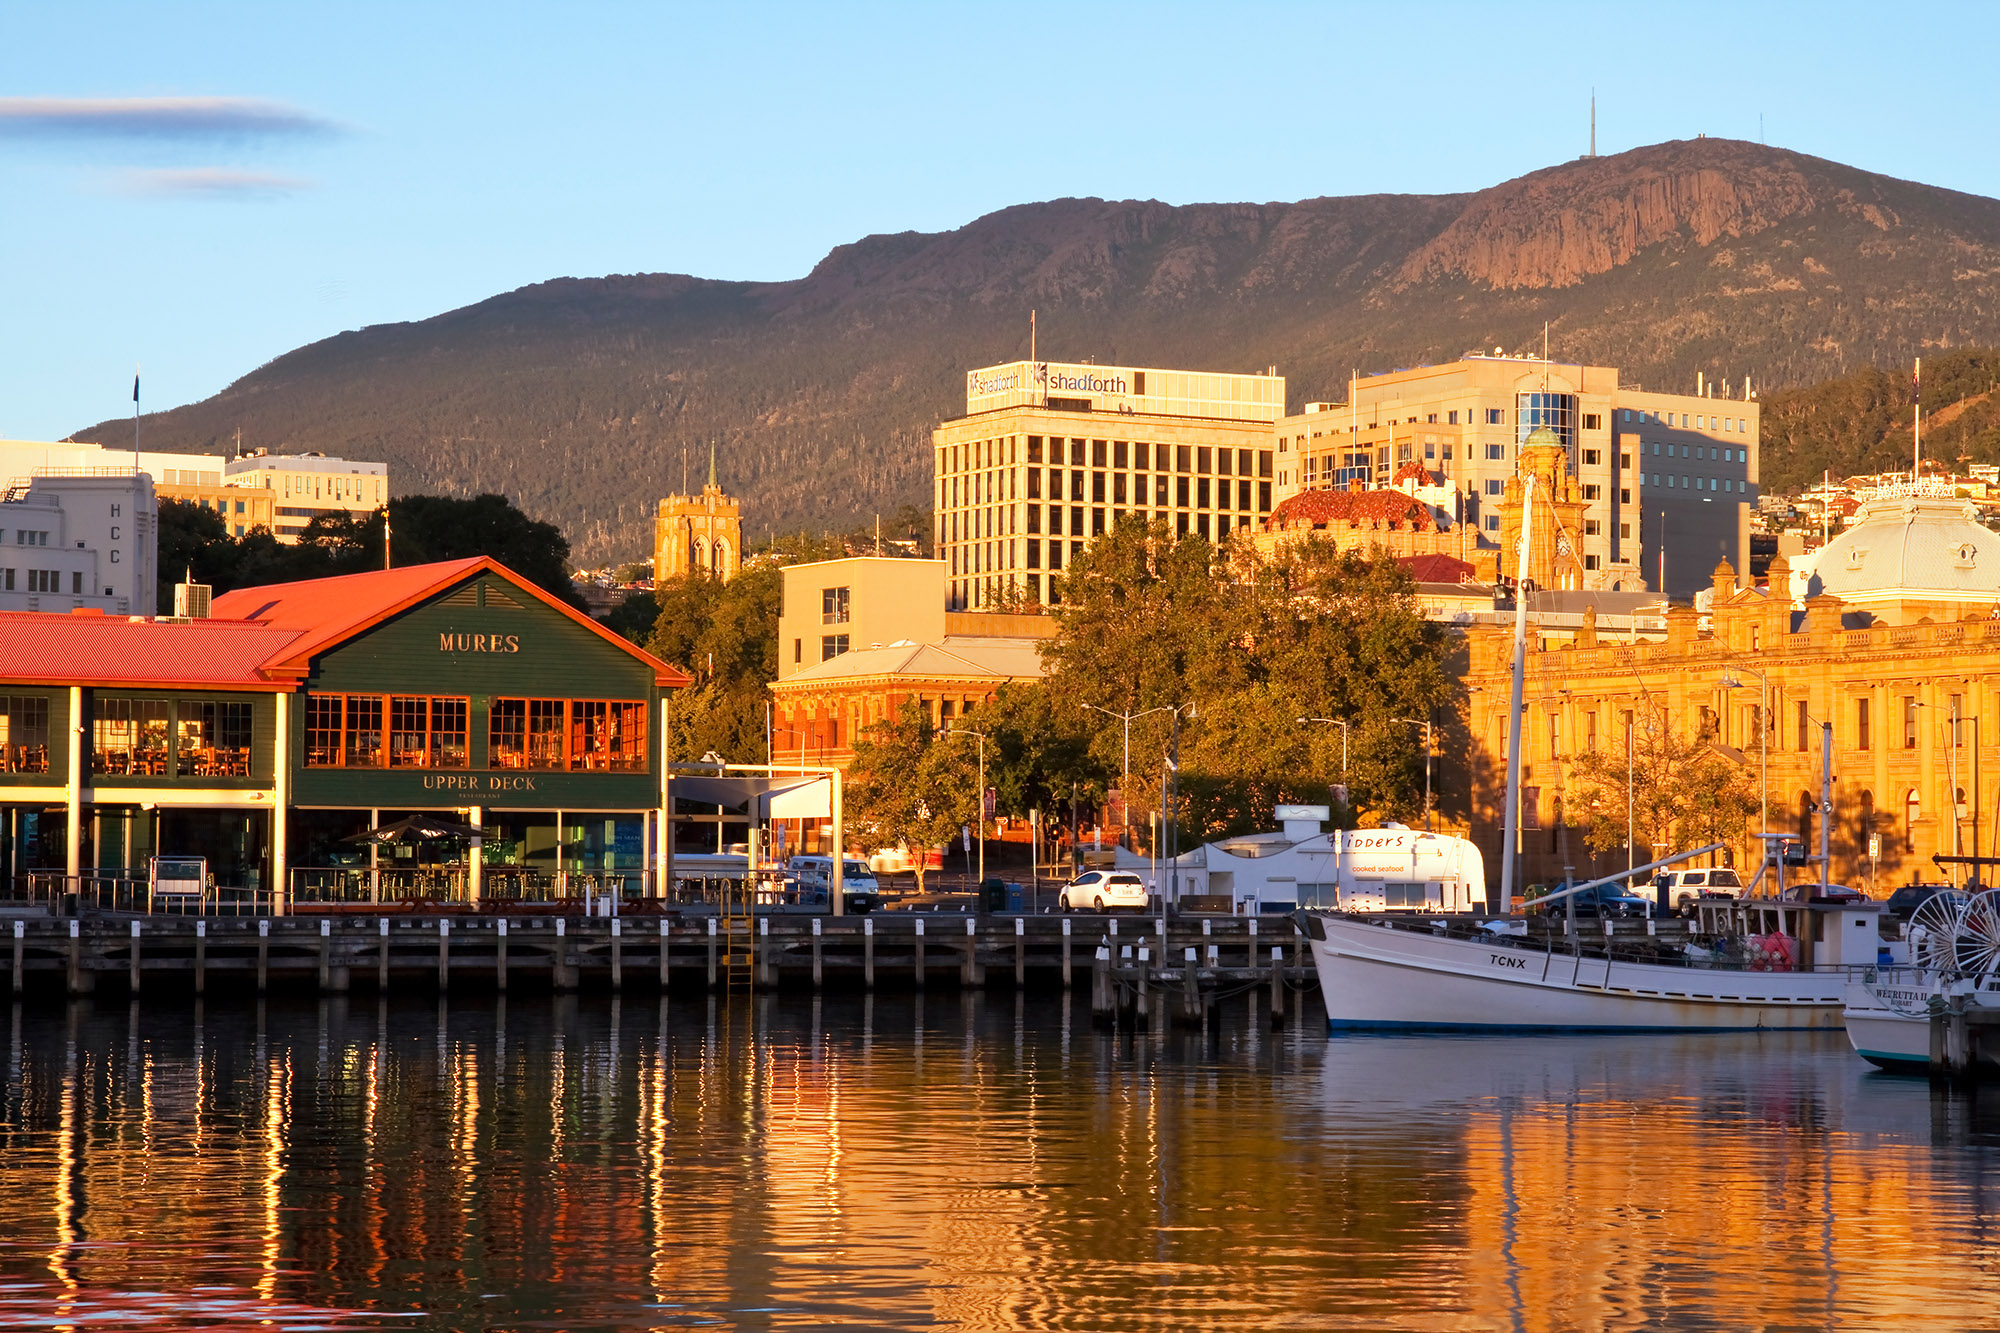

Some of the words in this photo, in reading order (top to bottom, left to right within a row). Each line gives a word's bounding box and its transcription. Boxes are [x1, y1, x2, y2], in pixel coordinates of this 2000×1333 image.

[978, 371, 1019, 394] shadforth
[1050, 372, 1126, 393] shadforth
[439, 632, 519, 653] MURES
[423, 775, 479, 790] UPPER
[490, 776, 536, 791] DECK
[1352, 865, 1376, 873] cooked
[1377, 865, 1404, 873] seafood
[1490, 954, 1527, 970] TCNX
